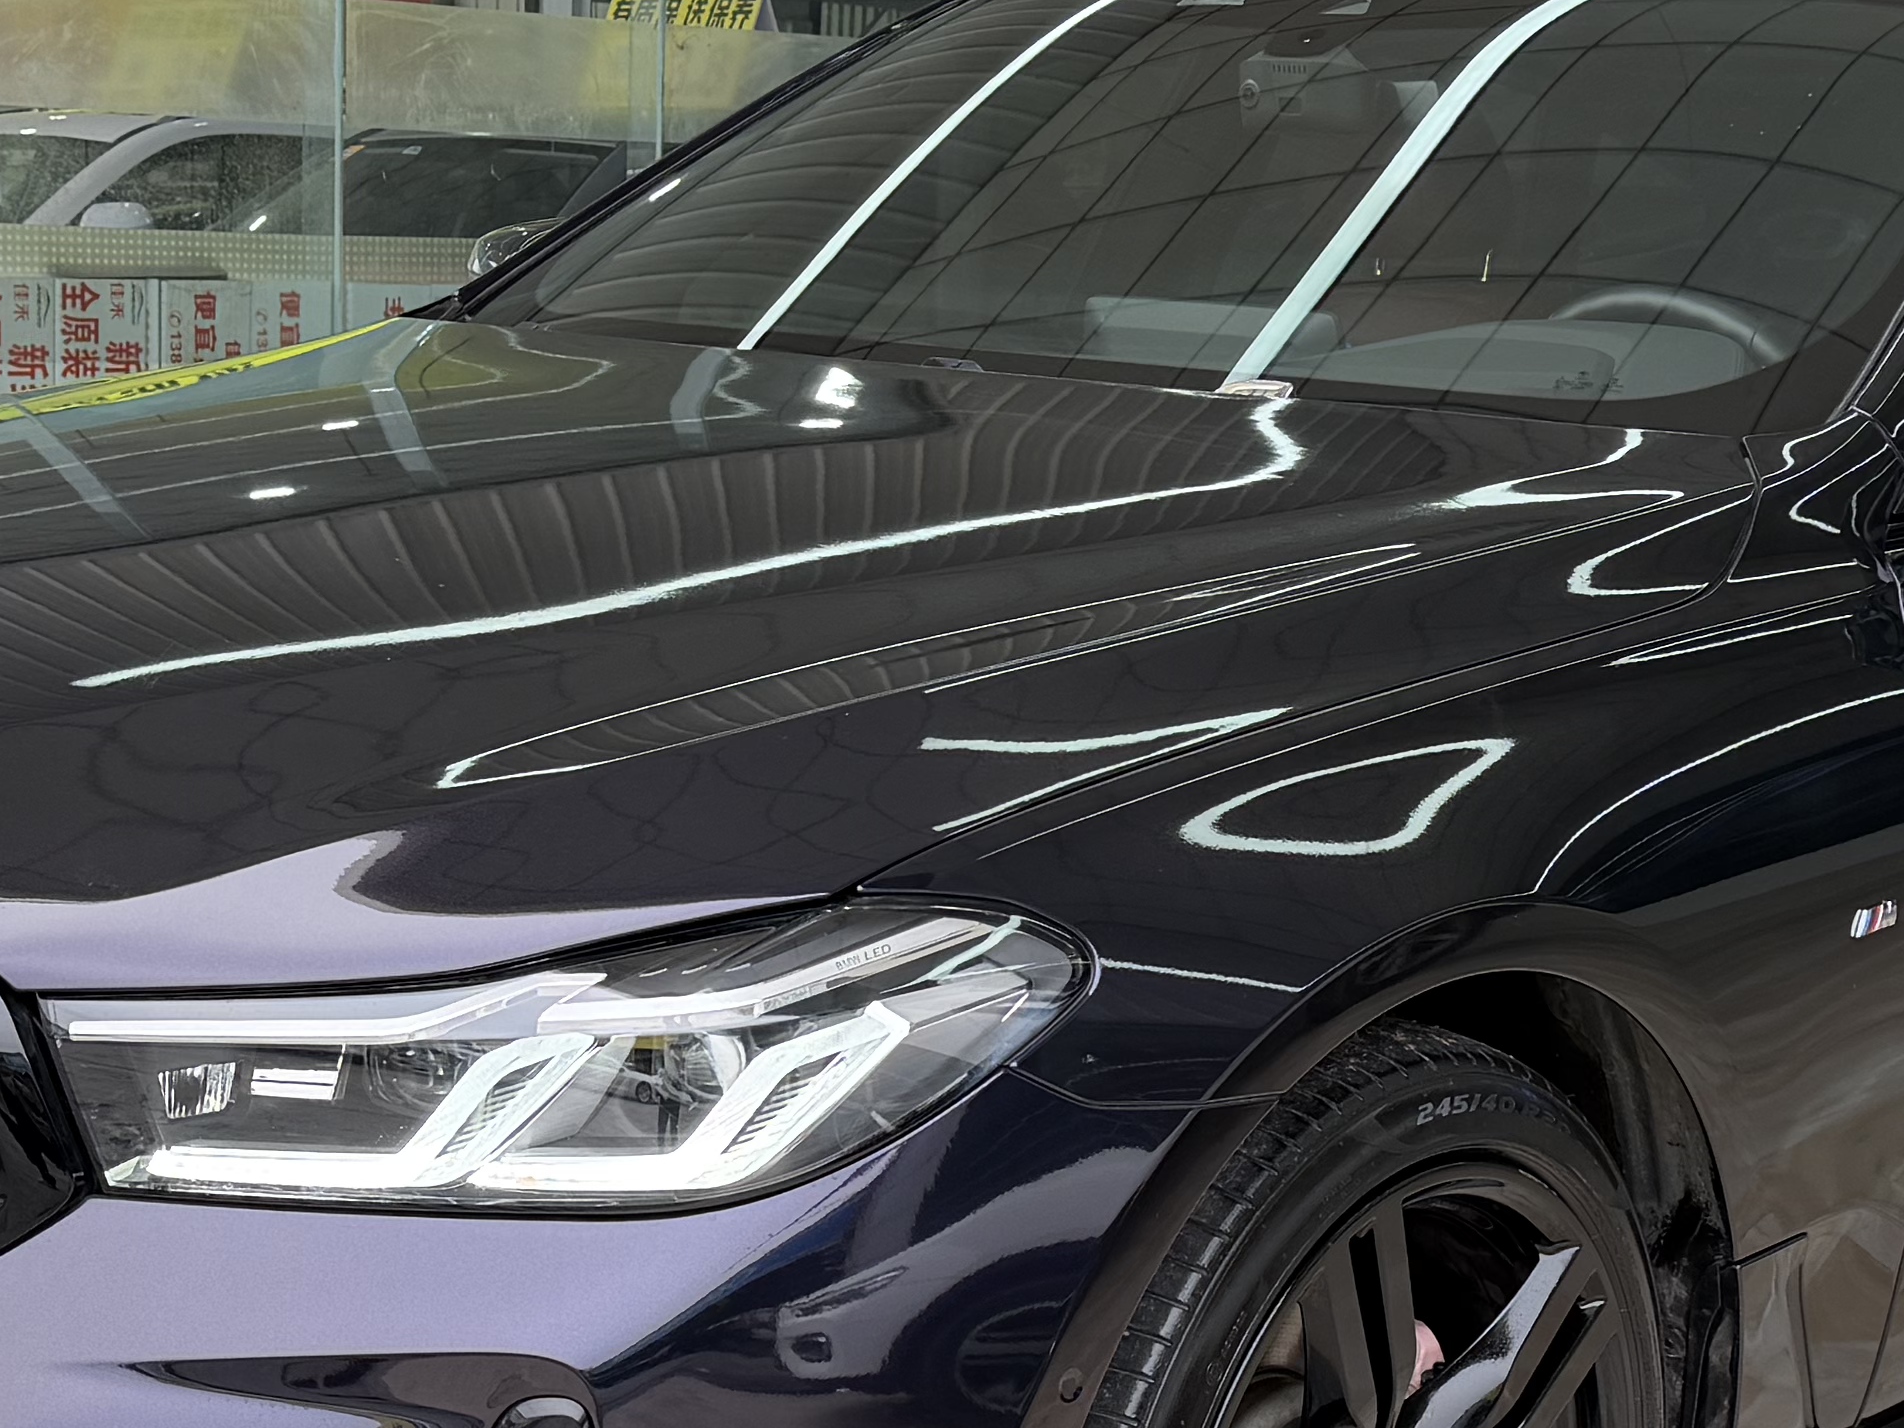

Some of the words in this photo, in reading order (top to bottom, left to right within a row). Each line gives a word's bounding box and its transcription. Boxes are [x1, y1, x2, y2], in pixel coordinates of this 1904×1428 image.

[60, 280, 102, 381] 全原装
[835, 954, 861, 971] BMW
[864, 943, 892, 961] LED
[1415, 1092, 1517, 1127] 245/40
